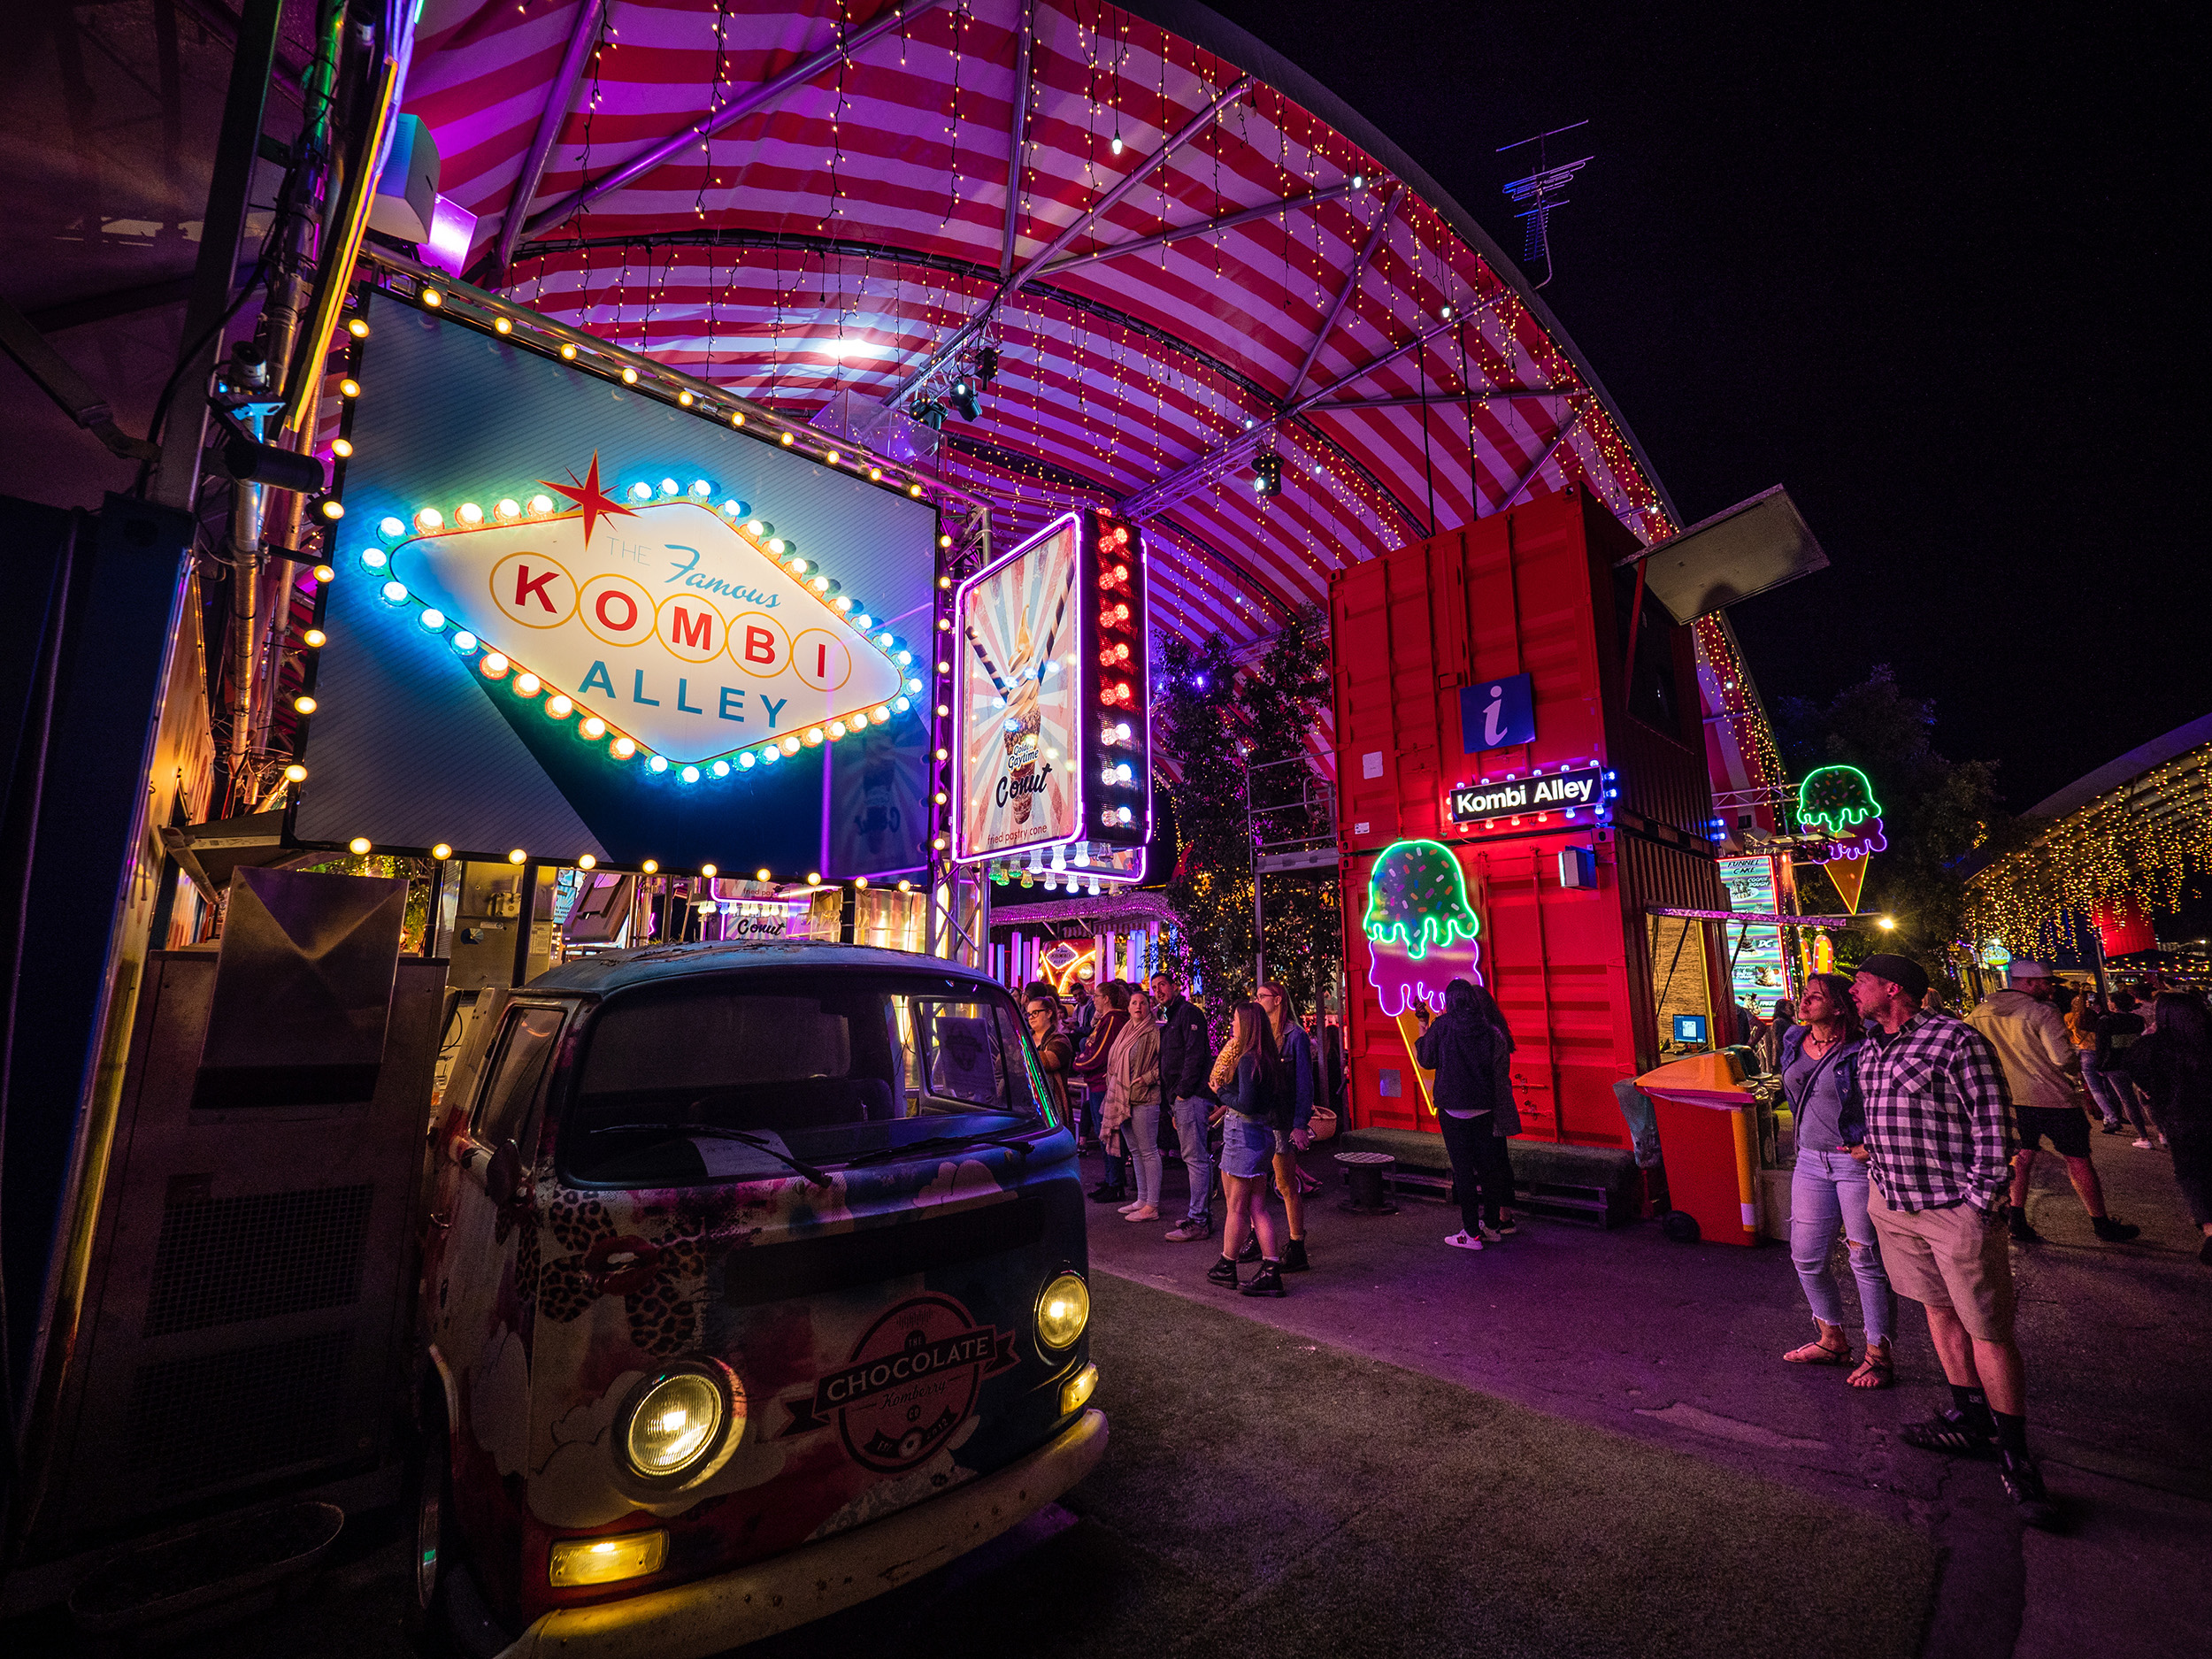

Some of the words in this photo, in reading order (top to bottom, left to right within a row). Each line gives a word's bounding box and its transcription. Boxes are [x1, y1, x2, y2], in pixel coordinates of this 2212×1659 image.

[606, 535, 652, 566] THE
[664, 543, 781, 609] Famous
[513, 564, 827, 679] KOMBI
[577, 660, 788, 729] ALLEY
[1008, 749, 1040, 771] Gaytime
[995, 762, 1053, 809] Conut
[1456, 785, 1527, 814] Kombi
[1533, 778, 1594, 808] Alley
[987, 833, 1003, 845] fried
[1005, 828, 1028, 844] pastry
[1029, 825, 1048, 836] cone
[1727, 859, 1761, 868] FUNNEL
[737, 918, 787, 936] Conut
[908, 1336, 923, 1348] THE
[826, 1336, 990, 1402] CHOCOLATE
